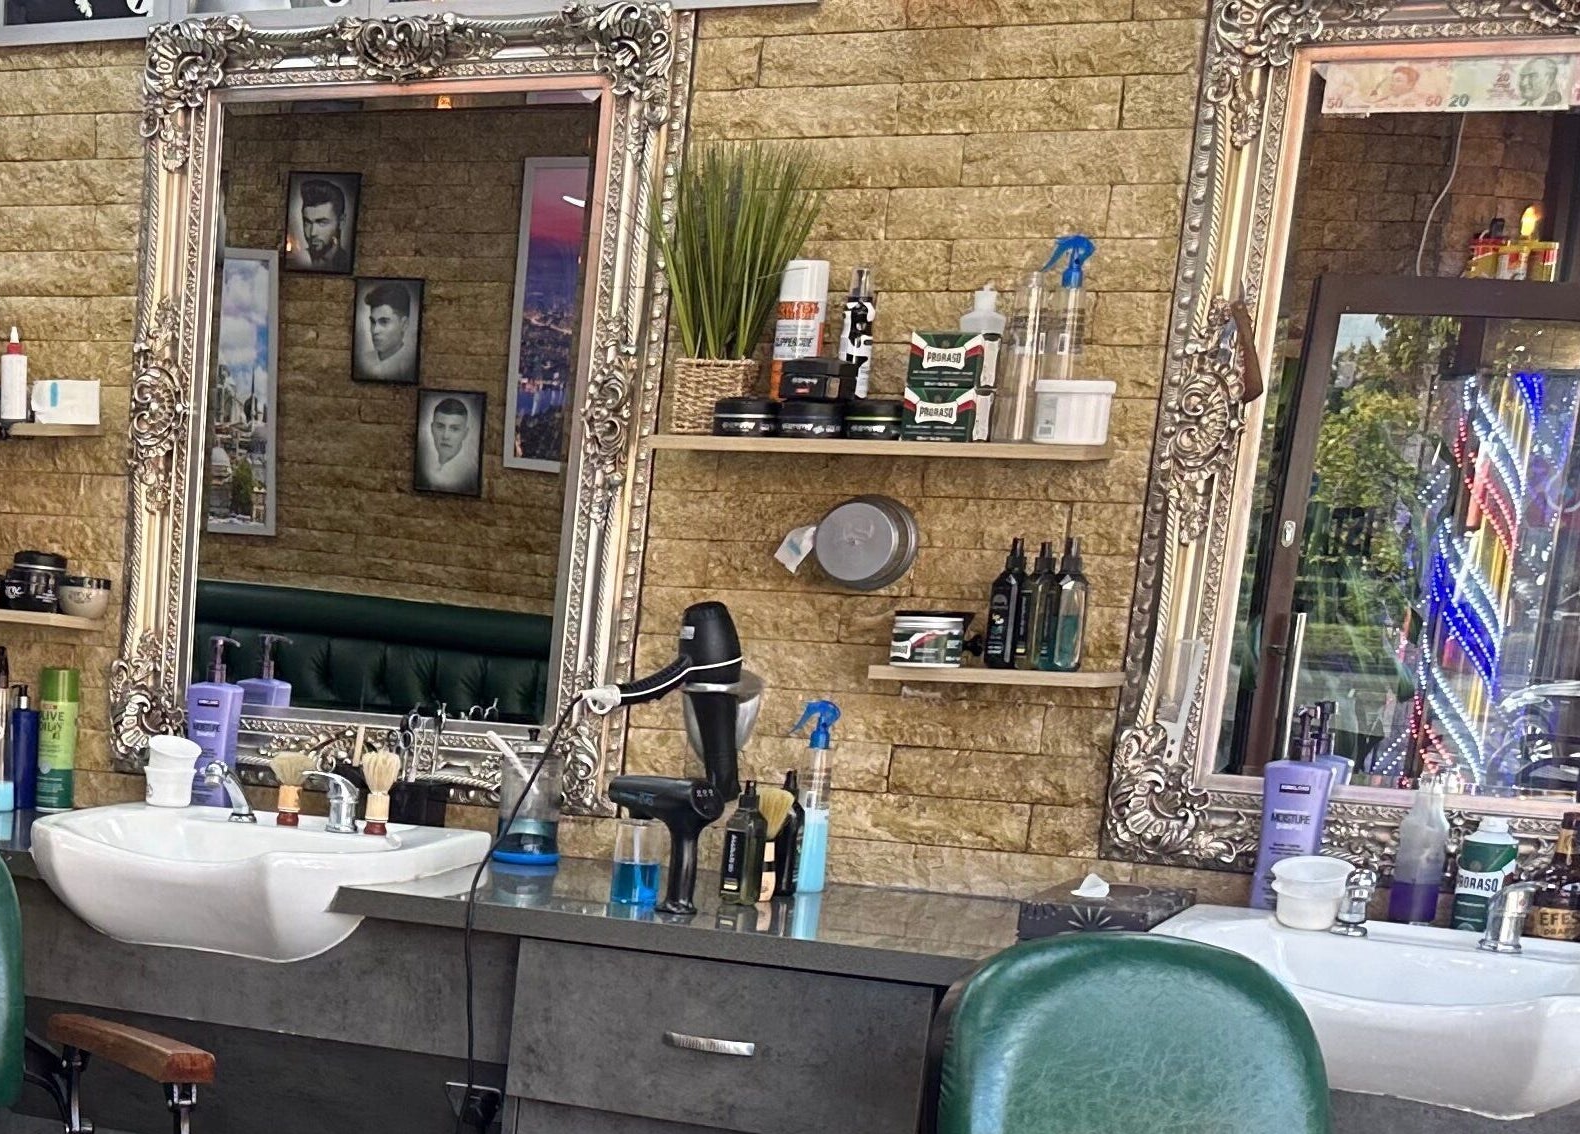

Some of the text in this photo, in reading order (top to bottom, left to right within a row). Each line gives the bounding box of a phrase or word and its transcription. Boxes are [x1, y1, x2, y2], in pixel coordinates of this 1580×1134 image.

[1426, 96, 1442, 107] 50
[1448, 94, 1469, 107] 20
[927, 351, 962, 364] PRORASO
[919, 406, 954, 419] PRORASO
[39, 711, 65, 722] LIVE
[1271, 813, 1311, 825] MOISTURE
[1458, 874, 1499, 893] RORASO
[1540, 912, 1580, 926] EFES
